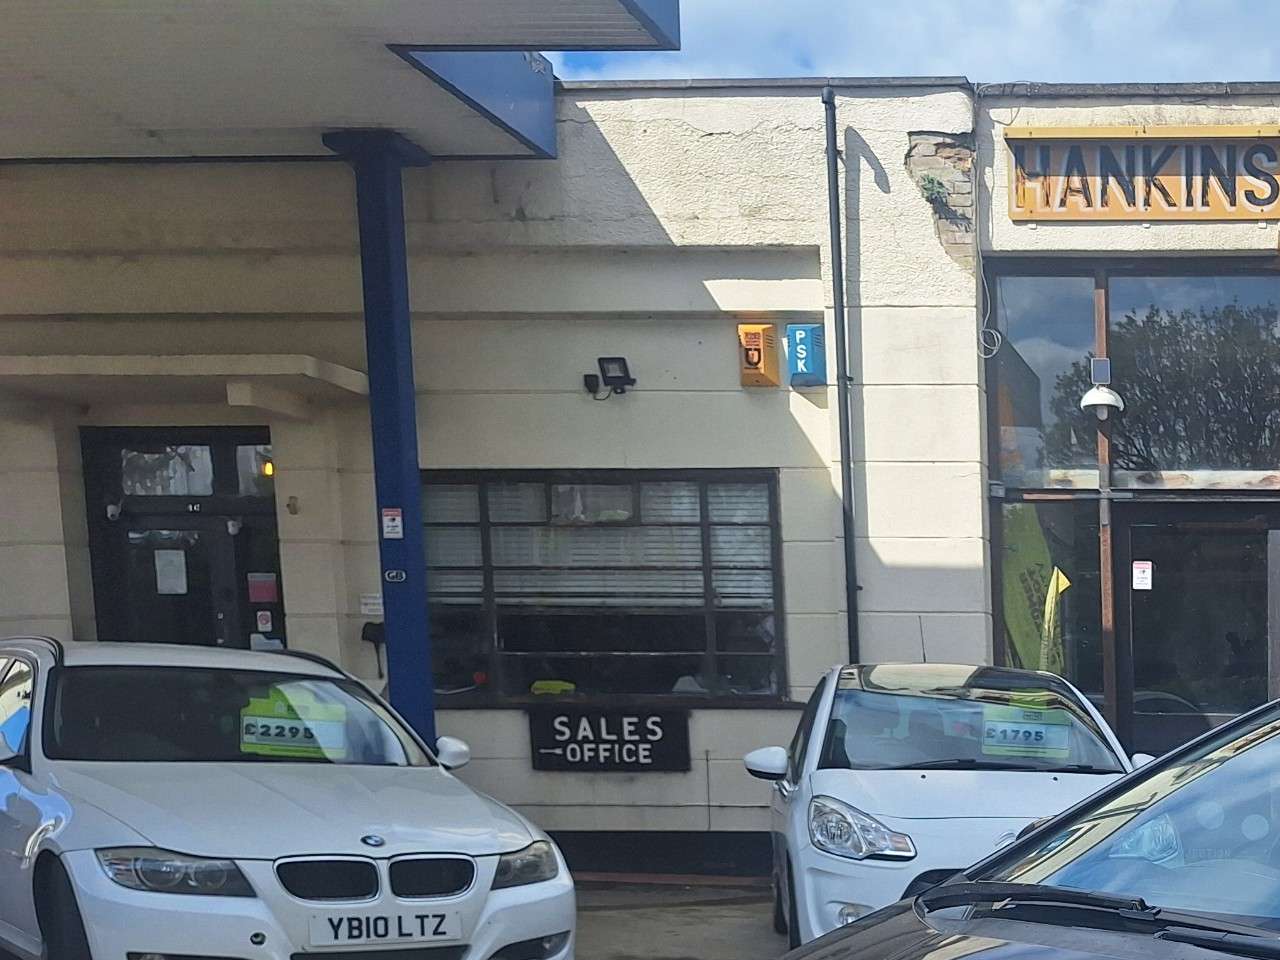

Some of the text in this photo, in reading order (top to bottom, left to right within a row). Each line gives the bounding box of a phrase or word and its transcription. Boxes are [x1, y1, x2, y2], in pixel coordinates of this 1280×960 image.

[1013, 143, 1280, 208] HANKINS
[795, 330, 807, 373] PSK
[553, 716, 663, 741] SALES
[985, 728, 1045, 742] £1795
[565, 743, 652, 763] OFFICE
[327, 914, 447, 940] YB10 LTZ
